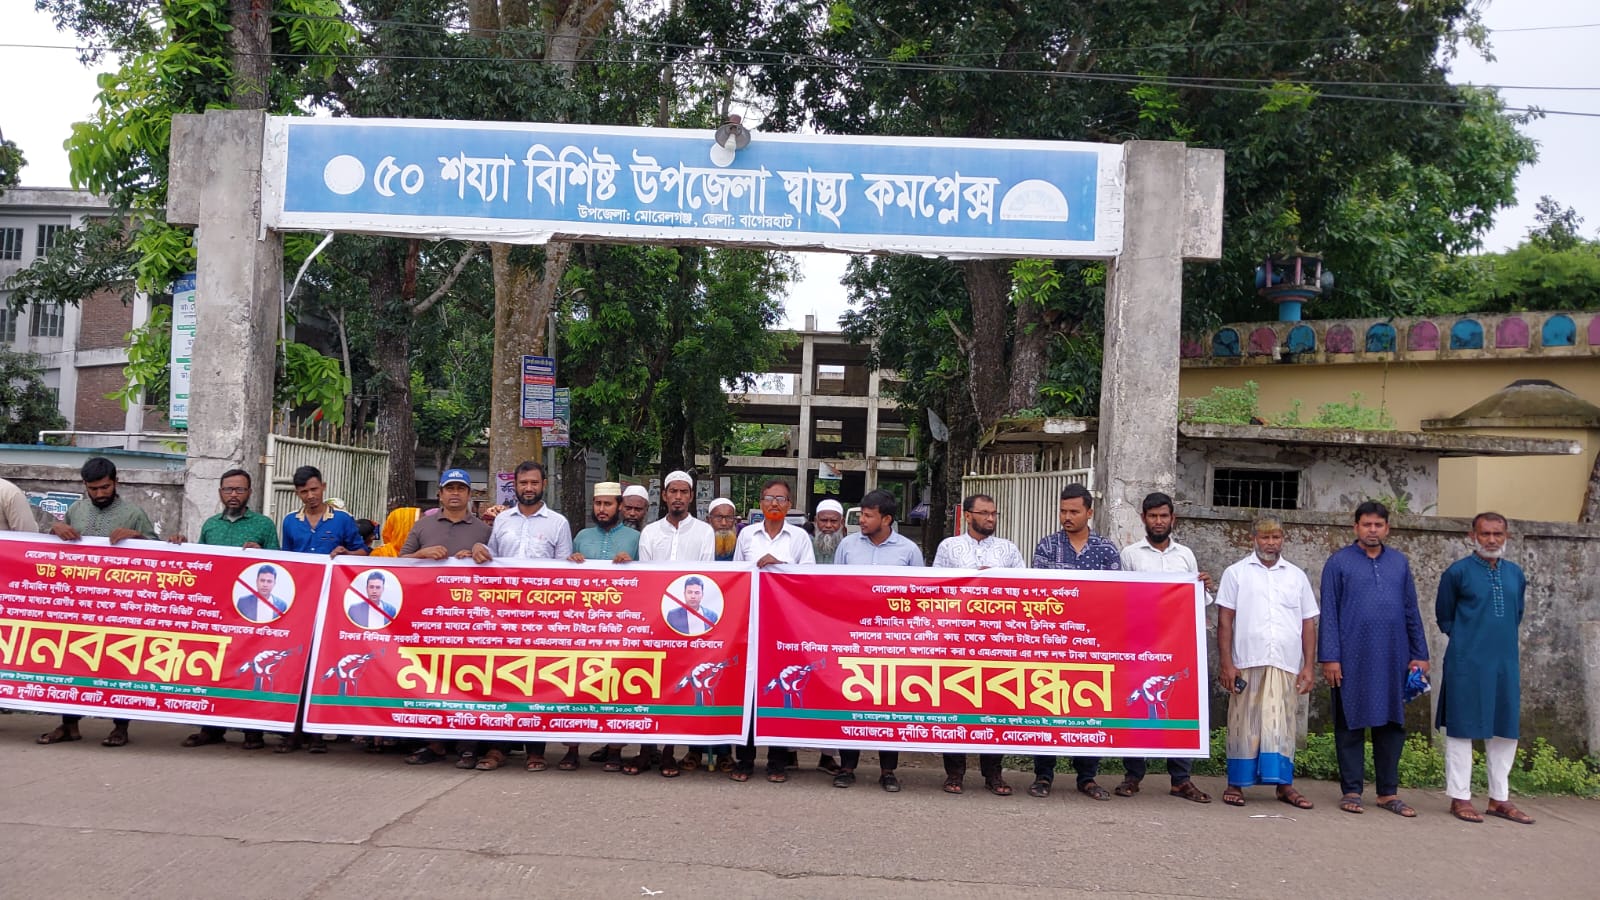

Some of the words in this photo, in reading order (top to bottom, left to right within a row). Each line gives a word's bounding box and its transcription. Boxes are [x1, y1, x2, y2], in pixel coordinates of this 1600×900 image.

[373, 155, 424, 197] ৫০
[438, 151, 516, 203] শয্যা
[522, 143, 622, 207] বিশিষ্ট
[629, 149, 772, 212] উপজেলা
[777, 167, 854, 229] স্বাস্থ্য
[861, 170, 1000, 225] কমপ্লেক্স
[35, 562, 56, 577] ডাঃ
[60, 564, 102, 580] কামাল
[104, 568, 153, 584] হোসেন
[155, 569, 197, 588] মুফতি
[449, 587, 473, 602] ডাঃ
[477, 588, 523, 603] কামাল
[526, 589, 577, 604] হোসেন
[580, 586, 623, 607] মুফতি
[886, 597, 911, 612] ডাঃ
[915, 597, 962, 613] কামাল
[966, 598, 1017, 614] হোসেন
[1020, 596, 1064, 617] মুফতি
[397, 647, 667, 702] মানববন্ধন
[838, 656, 1115, 715] মানববন্ধন
